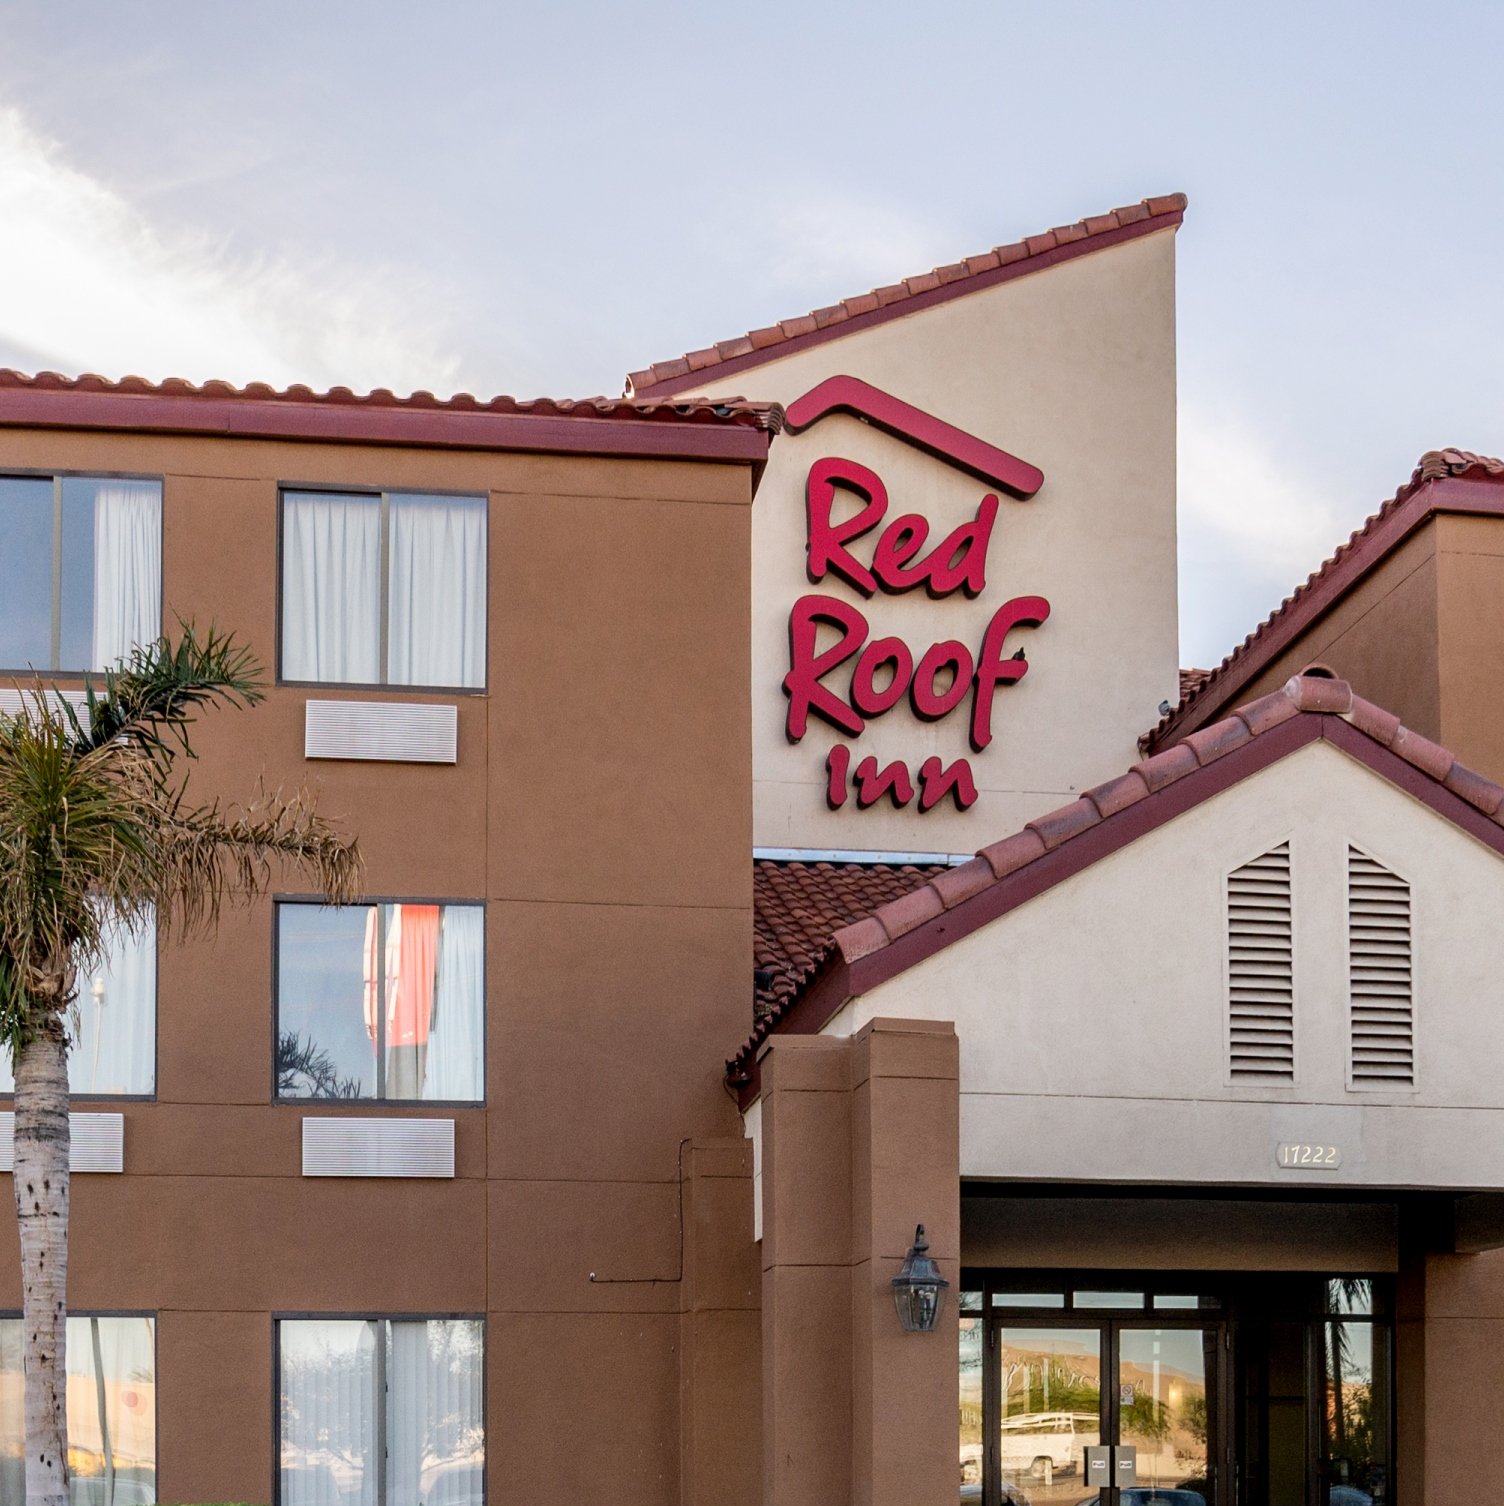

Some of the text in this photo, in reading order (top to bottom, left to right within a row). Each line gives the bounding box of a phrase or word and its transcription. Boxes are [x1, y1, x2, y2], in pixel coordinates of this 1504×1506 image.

[805, 457, 999, 598] Red
[782, 595, 1051, 752] Roof
[1283, 1145, 1336, 1164] 17222
